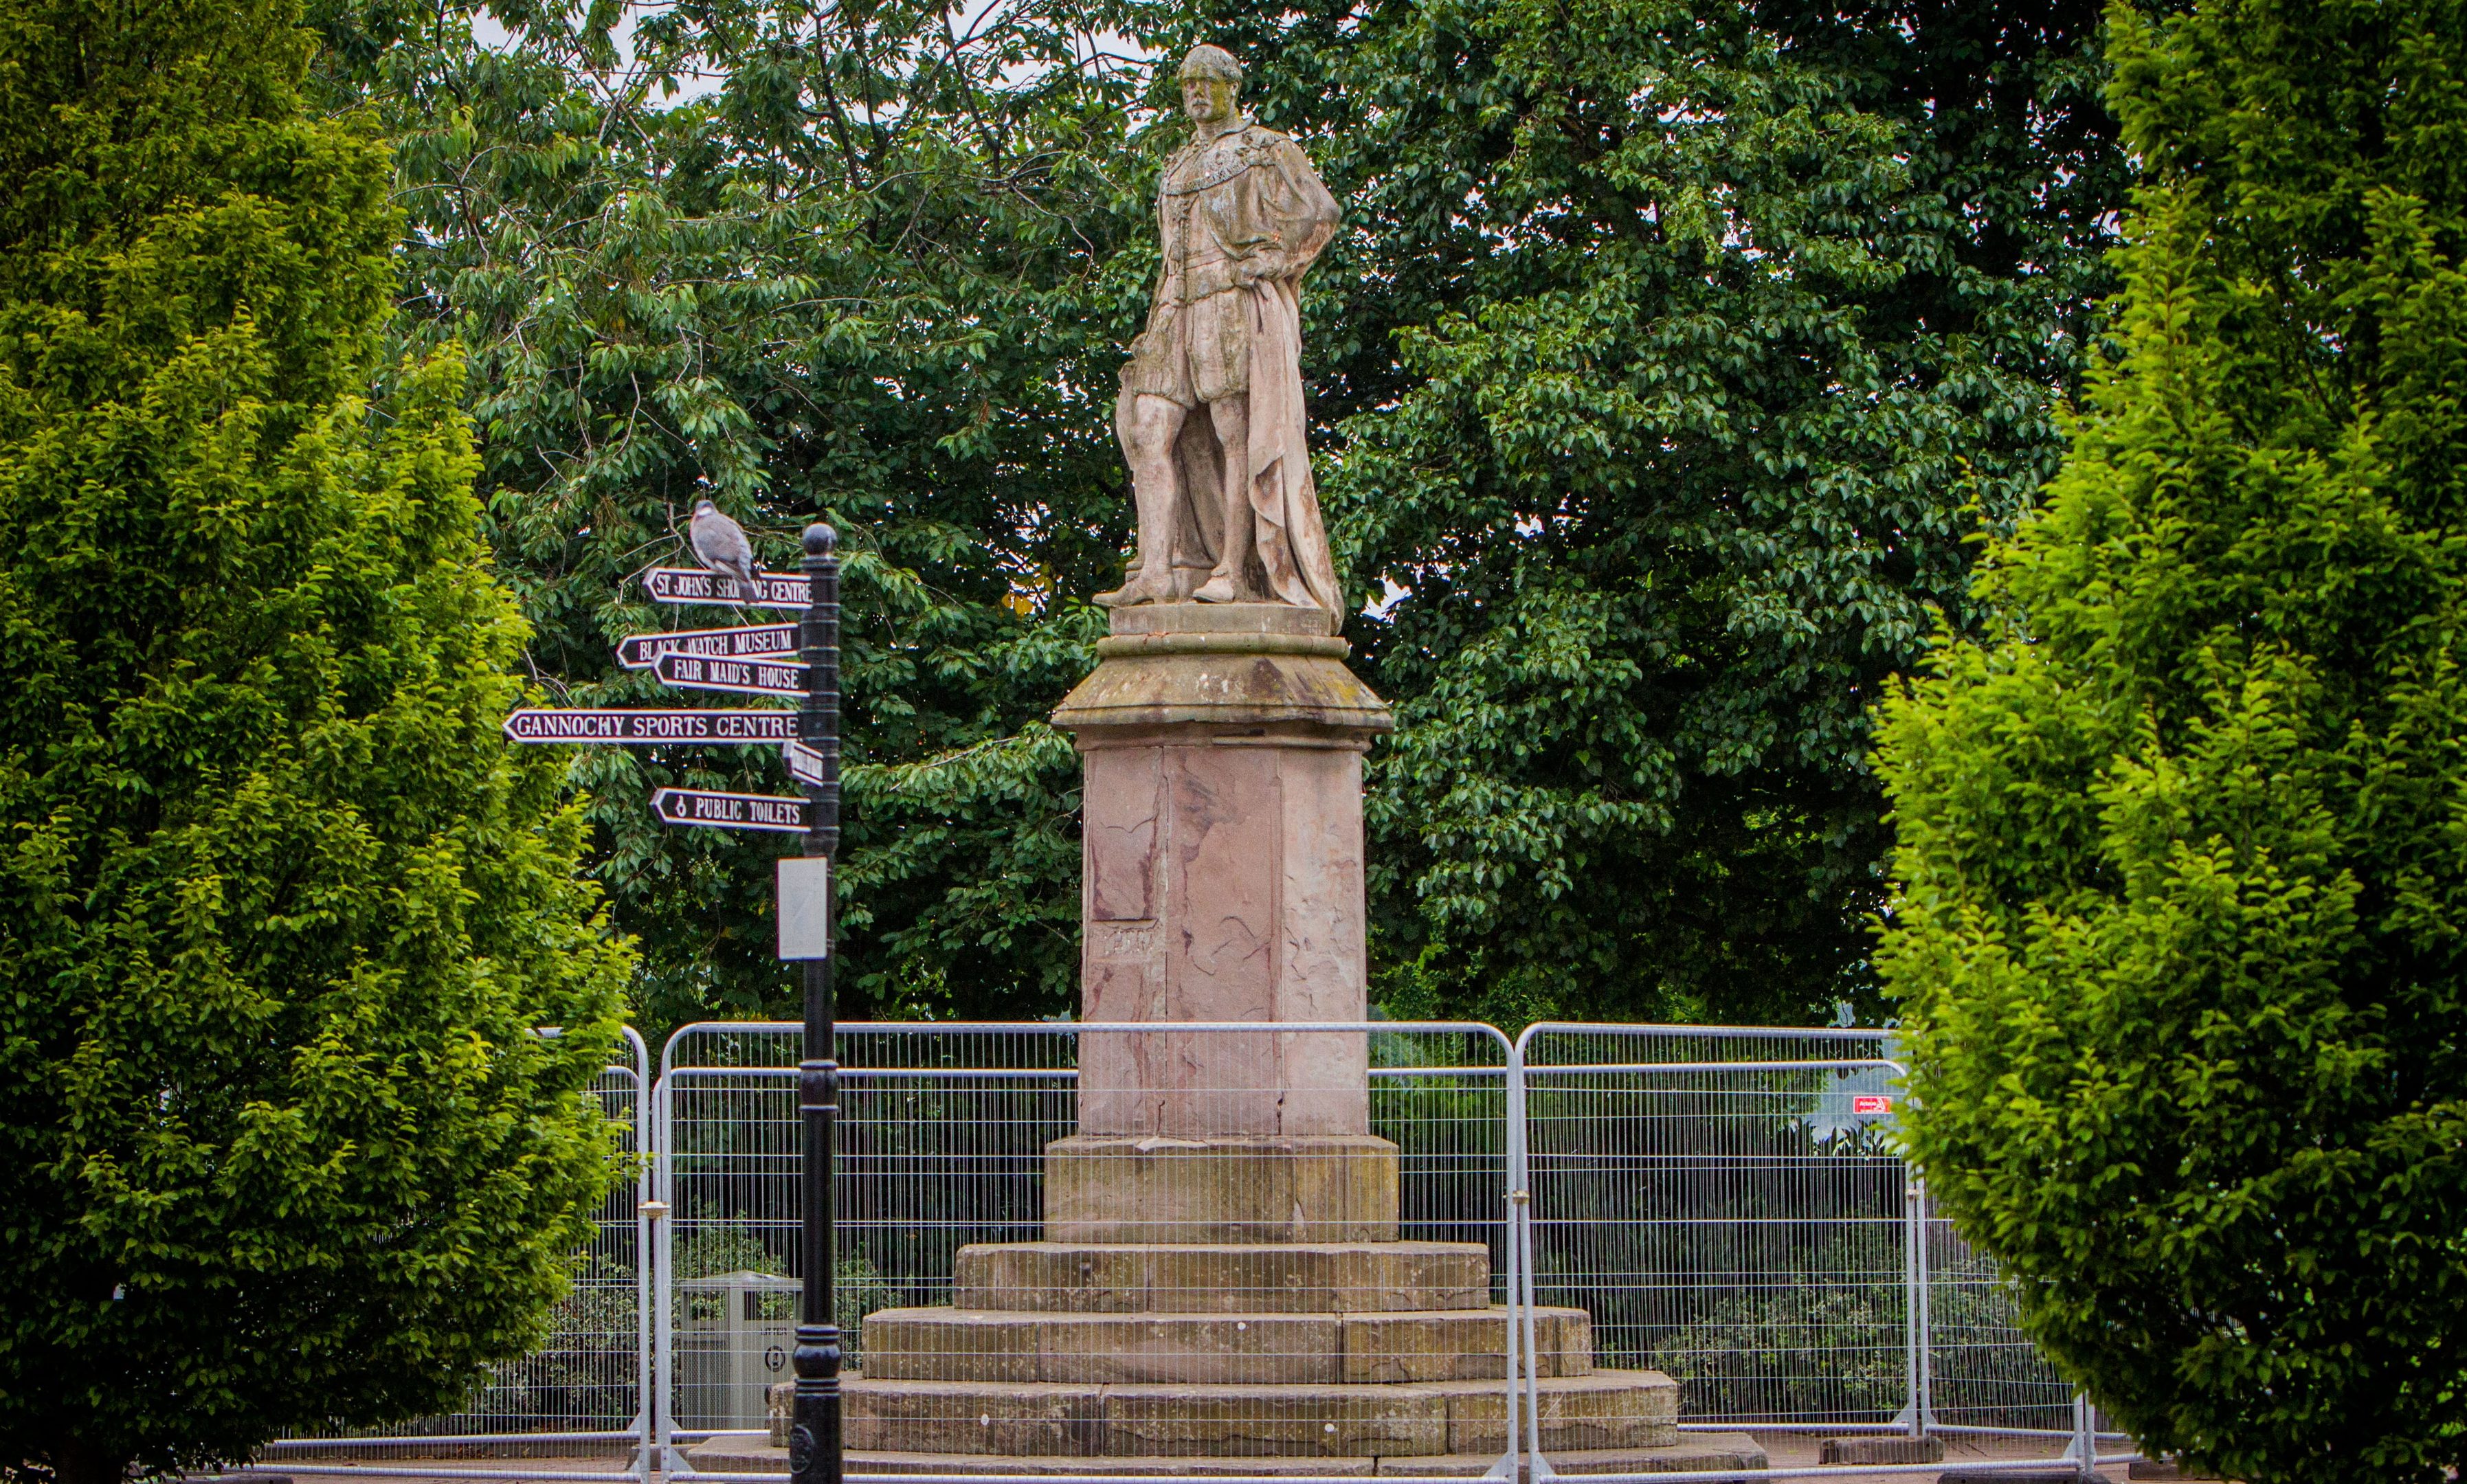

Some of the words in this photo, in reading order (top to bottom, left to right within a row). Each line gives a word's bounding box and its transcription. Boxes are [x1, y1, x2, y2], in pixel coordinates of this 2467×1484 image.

[656, 574, 671, 595] ST
[674, 575, 712, 597] JOHN'S
[716, 578, 768, 600] SHONG
[771, 581, 813, 603] CENTRE
[639, 638, 680, 661] BLACK
[687, 636, 728, 655] WATCH
[734, 630, 792, 653] MUSEUM
[674, 659, 702, 682] FAIR
[709, 662, 750, 685] MAID'S
[758, 666, 799, 690] HOUSE
[516, 716, 624, 737] GANNOCHY
[633, 716, 708, 737] SPORTS
[716, 716, 799, 737] CENTRE
[695, 796, 742, 821] PUBLIC
[749, 801, 801, 825] TOILETS
